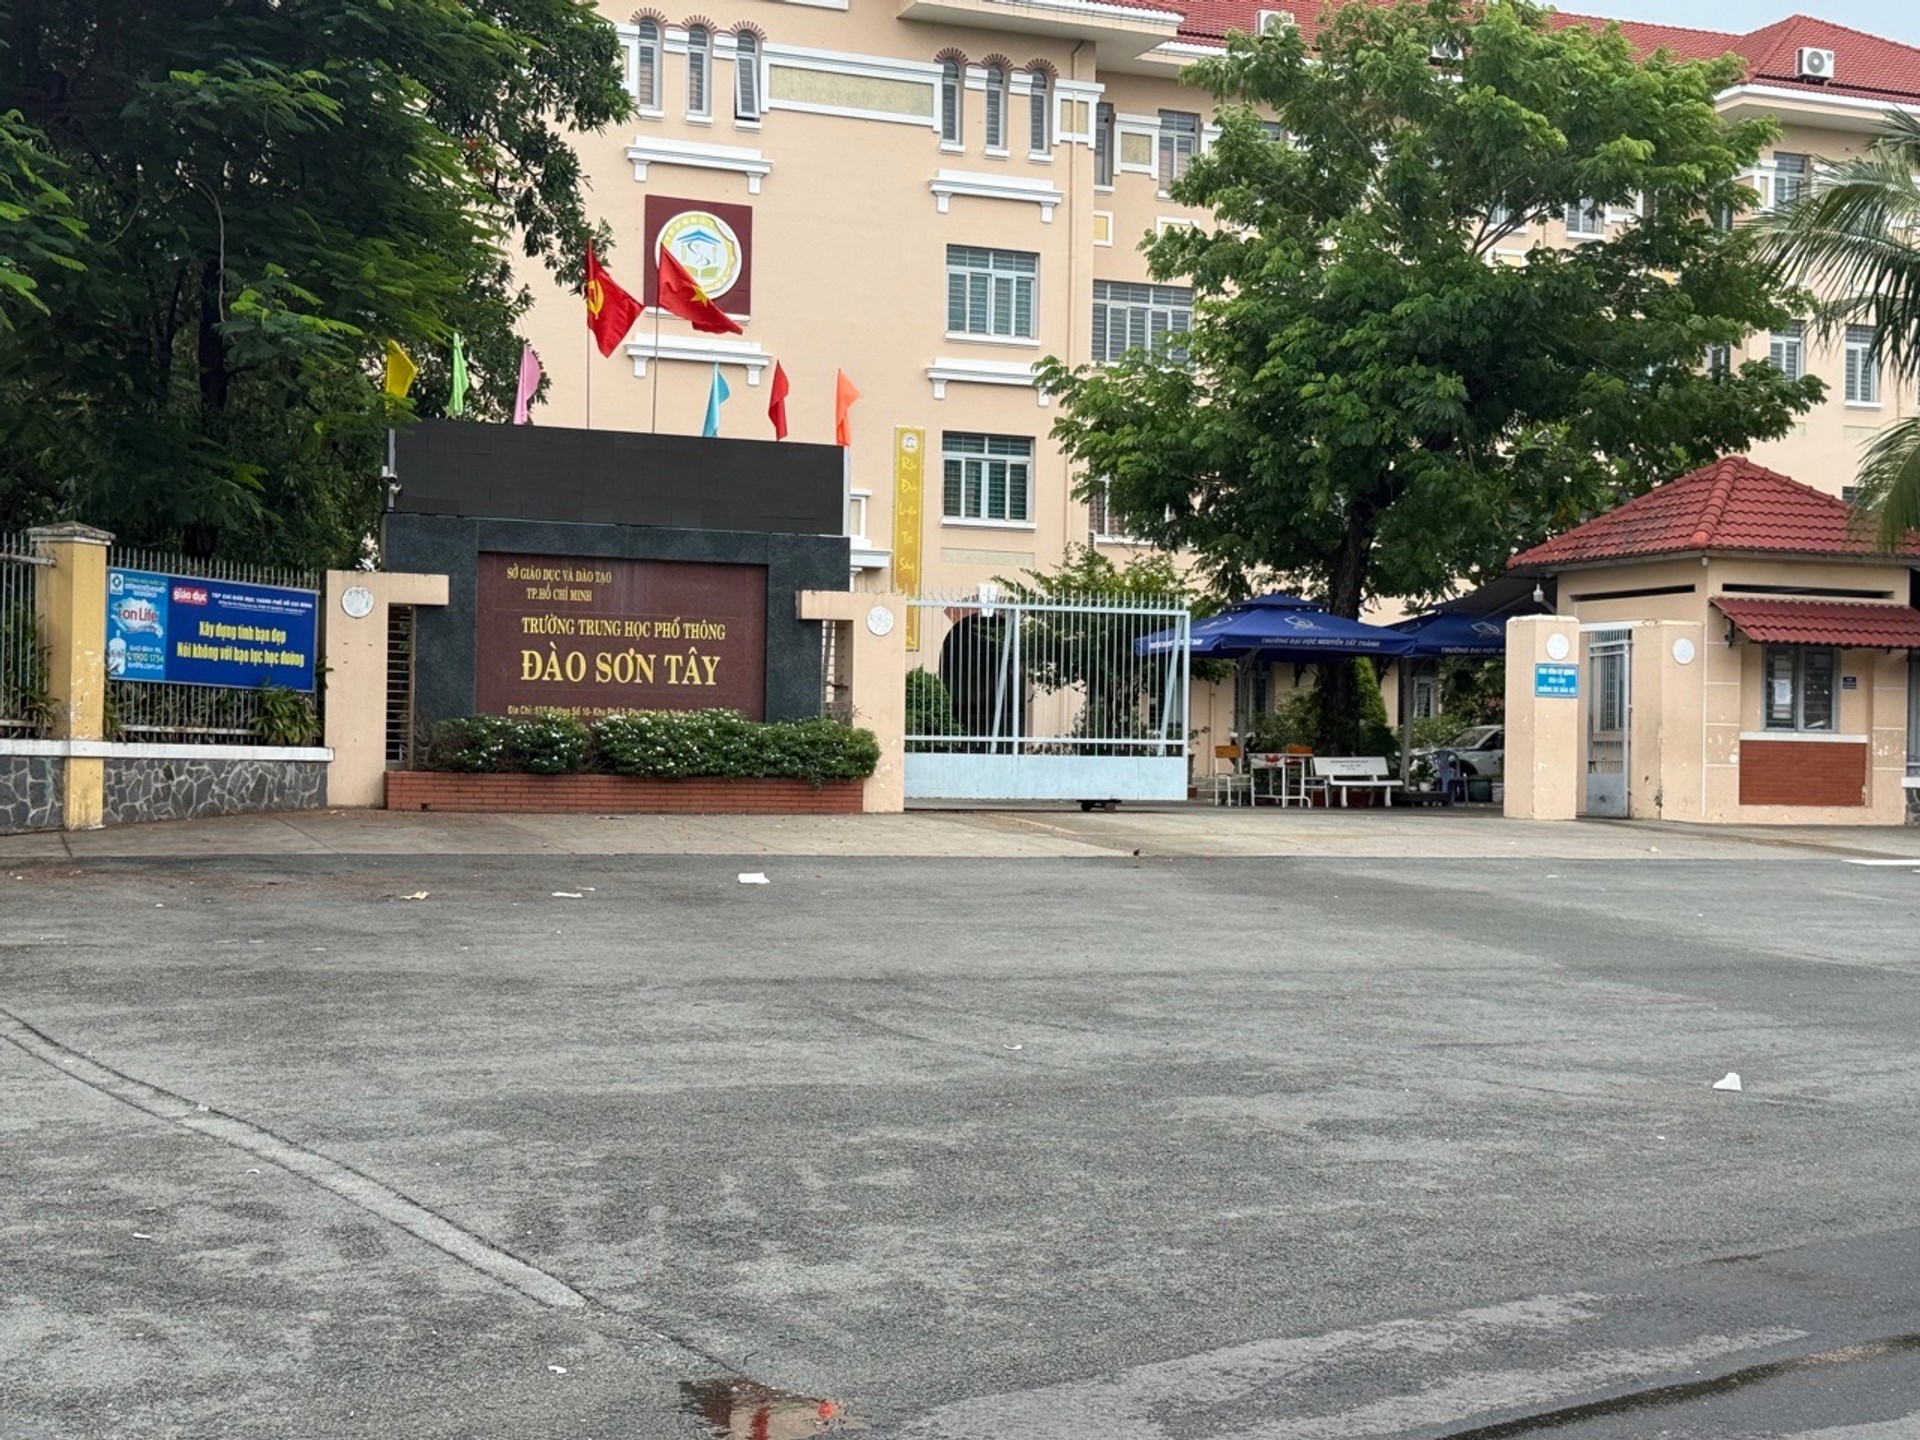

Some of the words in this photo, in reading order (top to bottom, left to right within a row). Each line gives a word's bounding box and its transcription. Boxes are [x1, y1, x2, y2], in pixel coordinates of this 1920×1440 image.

[507, 563, 519, 579] SỞ
[520, 566, 541, 581] GIÁO
[543, 569, 561, 584] DỤC
[563, 566, 574, 582] VÀ
[576, 568, 593, 583] ĐÀO
[595, 571, 612, 586] TẠO
[173, 588, 192, 601] giáo
[192, 591, 207, 601] dục
[526, 585, 552, 601] TP.HỒ
[554, 586, 568, 601] CHÍ
[570, 588, 592, 602] MINH
[199, 621, 215, 636] Xây
[216, 623, 236, 640] dựng
[238, 624, 254, 639] tình
[256, 626, 270, 644] bạn
[272, 628, 286, 646] đẹp
[522, 614, 575, 635] TRƯỜNG
[578, 620, 621, 637] TRUNG
[625, 623, 650, 641] HỌC
[654, 618, 681, 638] PHỔ
[682, 619, 726, 640] THÔNG
[177, 642, 192, 657] Nói
[192, 644, 219, 660] không
[220, 646, 233, 660] với
[234, 648, 248, 666] bạo
[251, 648, 263, 666] lực
[265, 650, 280, 666] học
[280, 650, 304, 667] đường
[521, 642, 587, 682] ĐÀO
[596, 648, 656, 684] SƠN
[665, 647, 721, 686] TÂY
